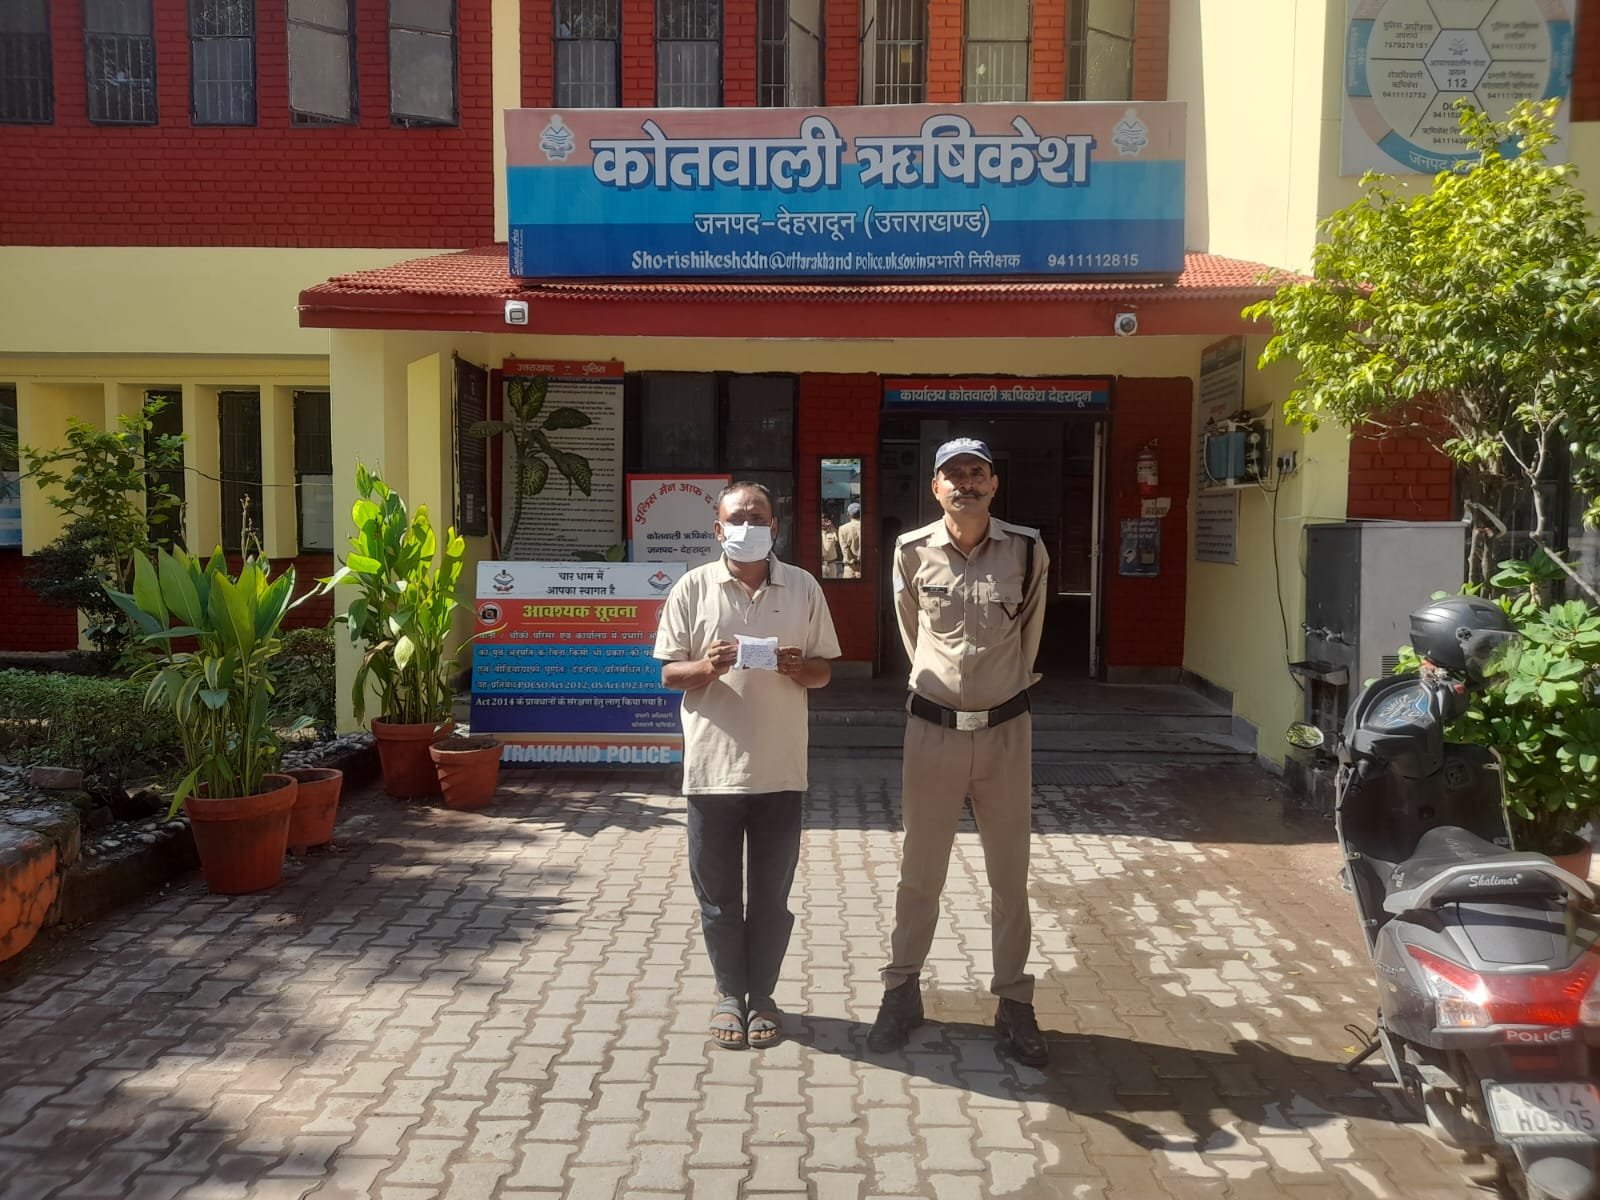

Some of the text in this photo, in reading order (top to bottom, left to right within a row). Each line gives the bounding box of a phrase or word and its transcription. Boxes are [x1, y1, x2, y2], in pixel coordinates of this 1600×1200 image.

[1448, 79, 1468, 89] 112
[590, 114, 1096, 190] कोतवाली ऋषिकेश
[864, 204, 991, 238] (उत्तराखण्ड)
[968, 250, 1021, 269] निरीक्षक
[1047, 253, 1139, 268] 9411112815
[900, 384, 1092, 407] कार्यालय कोतवाली ऋषिकेश देहरादून
[635, 493, 657, 525] पुलिस
[646, 531, 681, 541] कोतवाली
[558, 570, 605, 581] चार धाम में
[547, 584, 616, 596] आपका स्वागत है
[522, 605, 638, 622] आवश्यक सूचना
[490, 698, 514, 706] 2014
[606, 745, 671, 764] POLICE
[1468, 875, 1519, 888] Shalimar
[1506, 1029, 1571, 1043] POLICE
